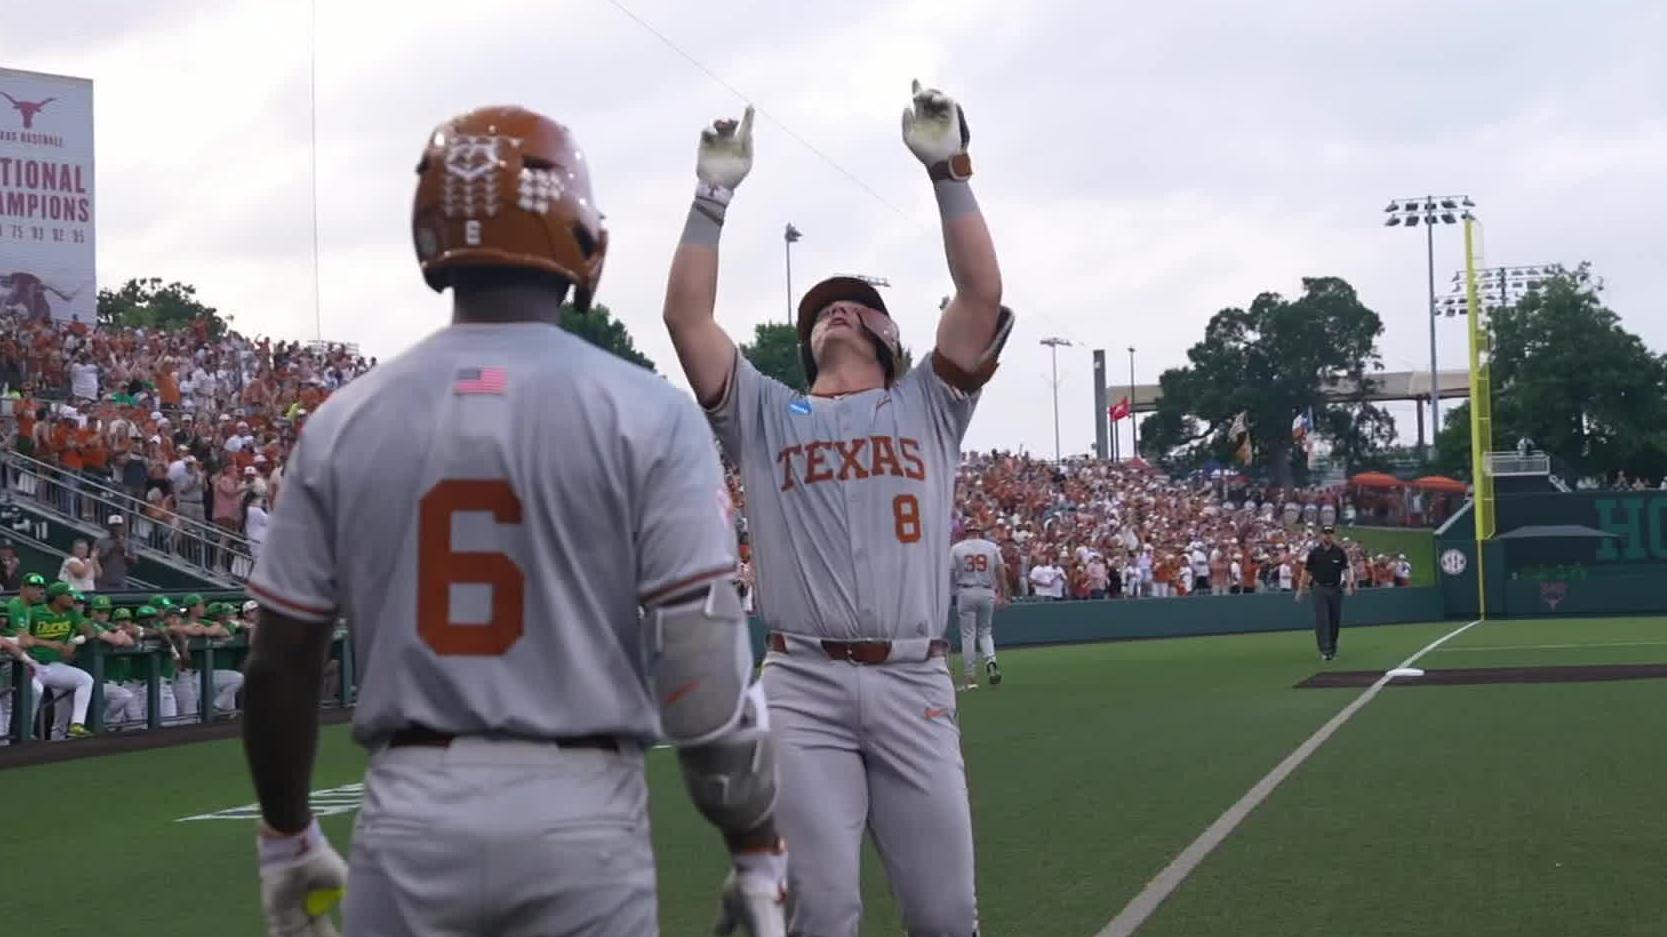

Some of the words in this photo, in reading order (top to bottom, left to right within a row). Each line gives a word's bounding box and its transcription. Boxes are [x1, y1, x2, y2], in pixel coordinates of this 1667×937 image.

[21, 131, 64, 148] BASEBALL
[0, 157, 86, 193] TIONAL
[465, 220, 481, 245] 6
[776, 435, 925, 493] TEXAS
[892, 494, 922, 544] 8
[417, 478, 525, 656] 6
[963, 554, 988, 572] 39
